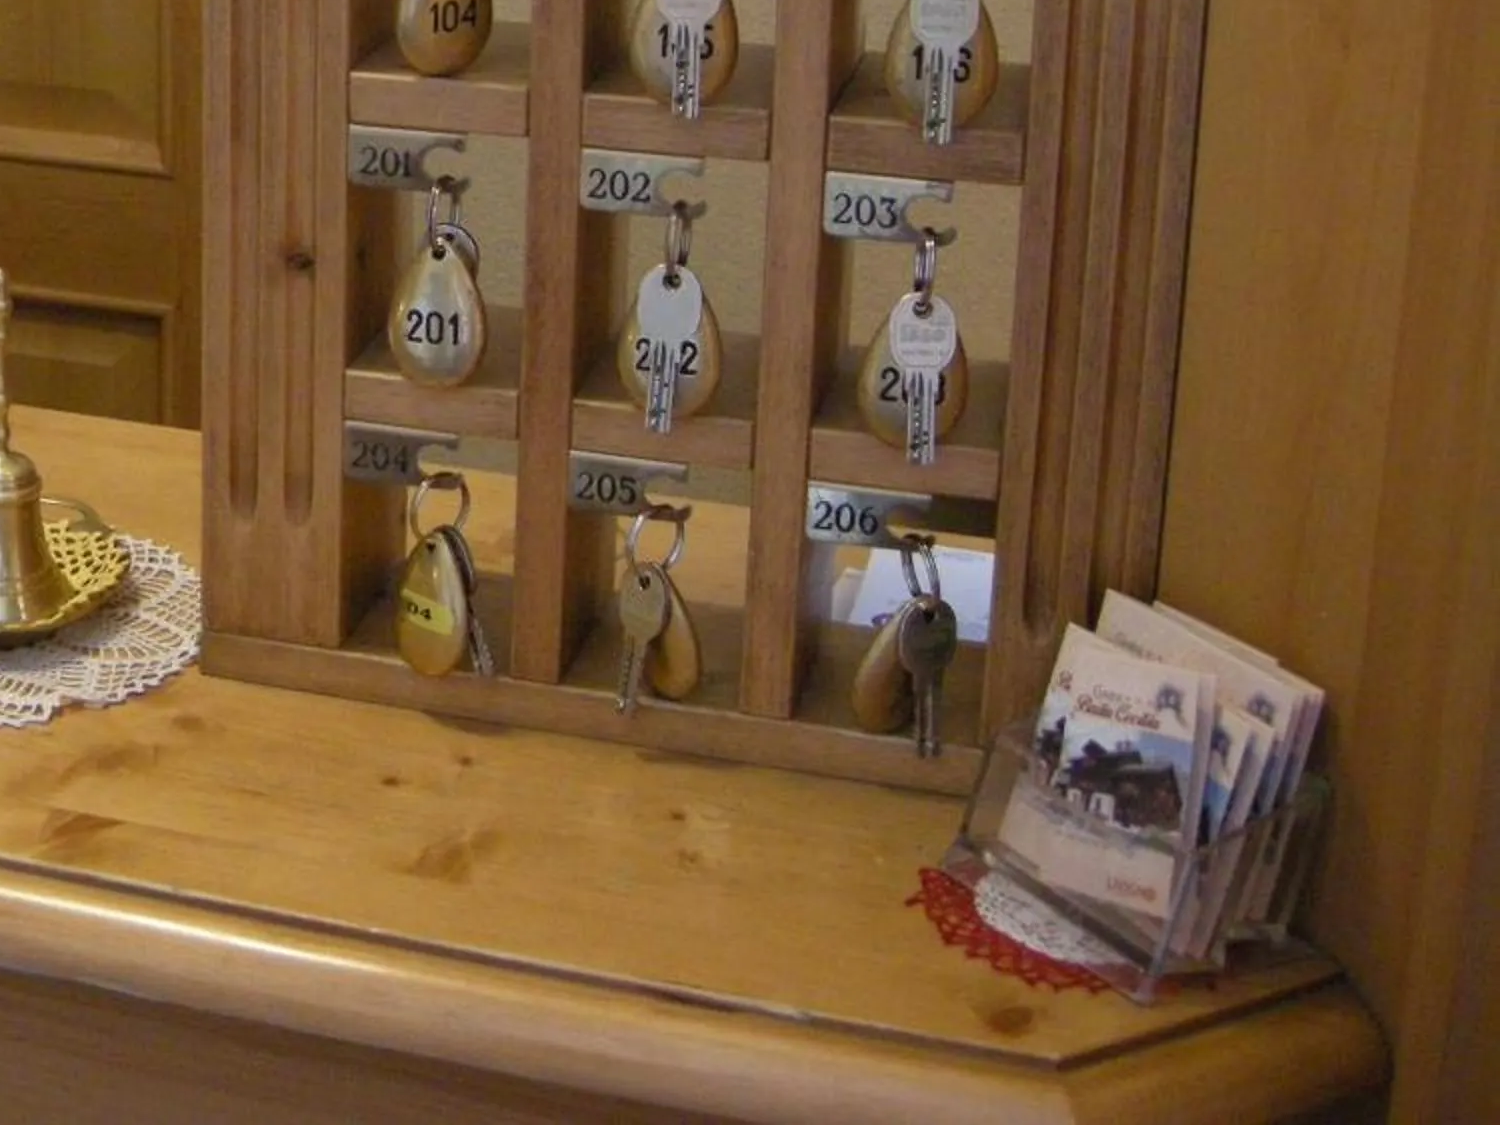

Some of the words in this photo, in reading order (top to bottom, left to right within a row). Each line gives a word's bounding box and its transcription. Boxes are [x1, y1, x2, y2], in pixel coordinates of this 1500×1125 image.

[658, 22, 715, 60] 15
[912, 45, 973, 83] 16
[359, 146, 413, 179] 201
[587, 168, 652, 204] 202
[832, 193, 899, 229] 203
[406, 309, 460, 346] 201
[635, 337, 699, 376] 22
[350, 441, 410, 474] 204
[574, 471, 638, 506] 205
[812, 500, 879, 536] 206
